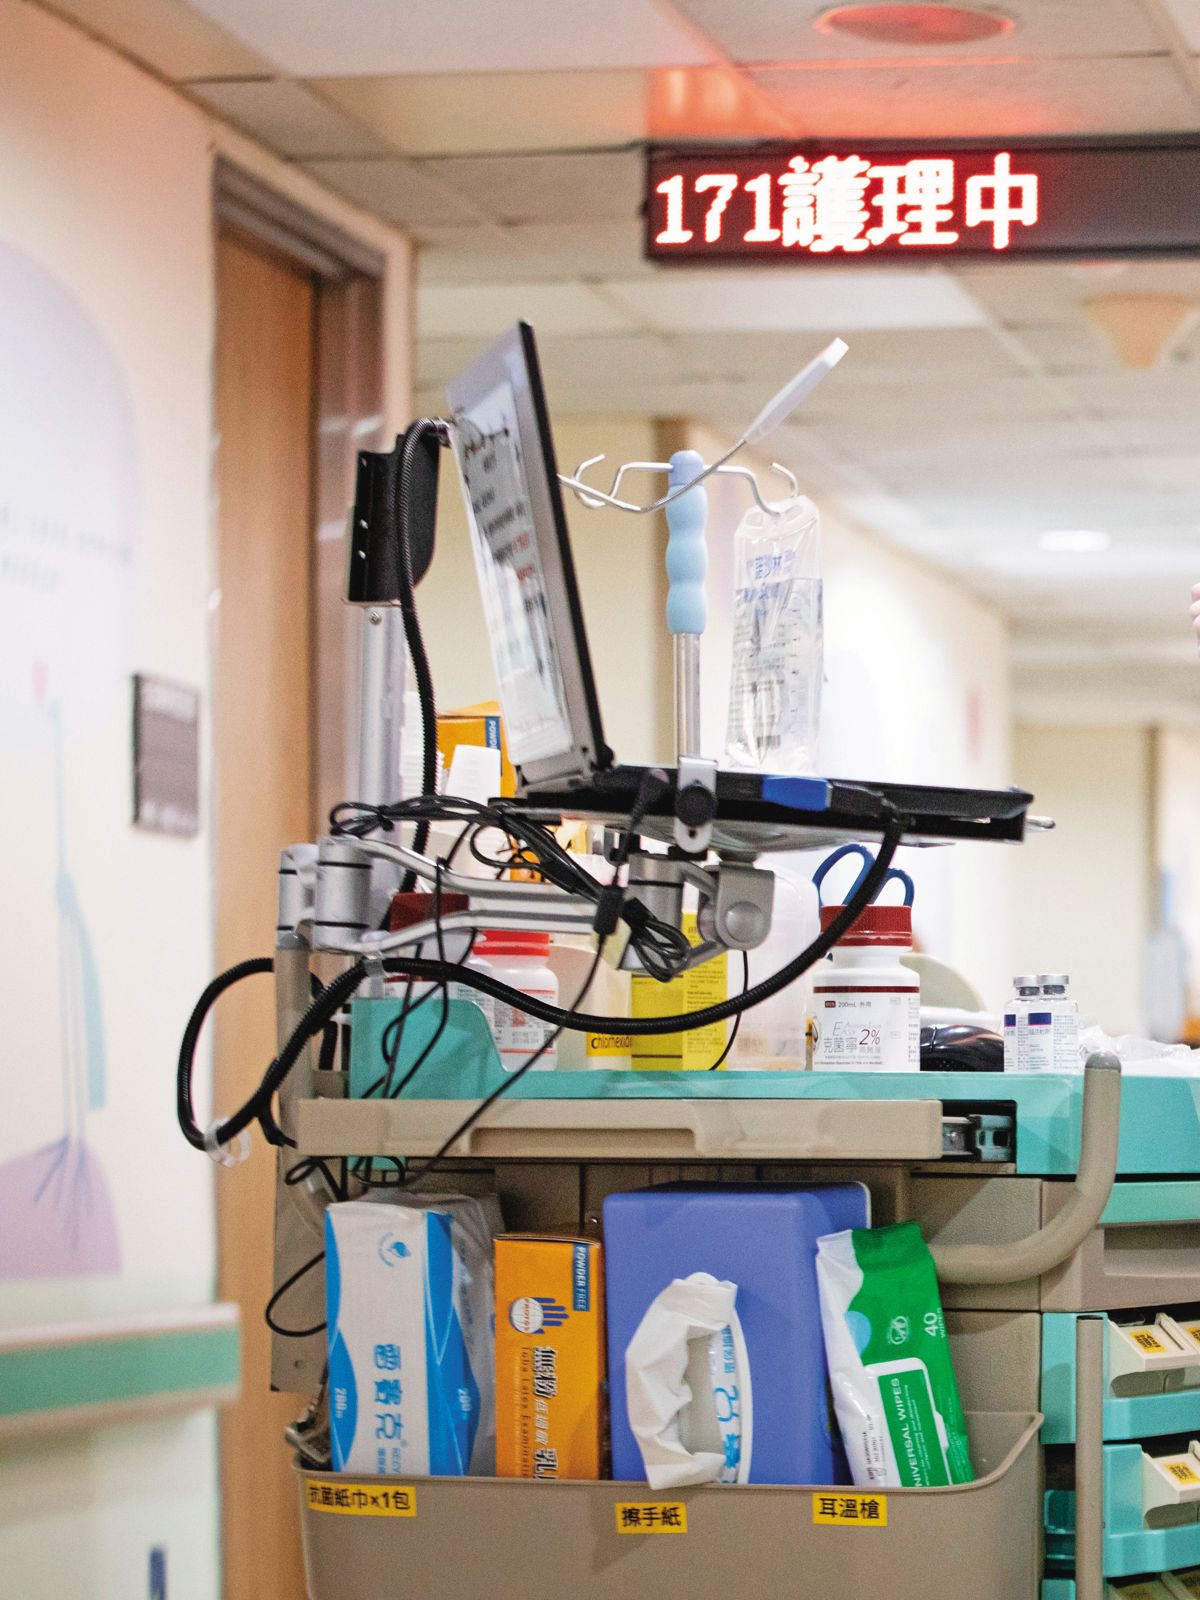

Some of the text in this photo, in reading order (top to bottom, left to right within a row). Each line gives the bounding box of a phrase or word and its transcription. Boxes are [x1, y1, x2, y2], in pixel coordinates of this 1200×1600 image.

[655, 152, 1039, 252] 171護理中
[859, 1028, 881, 1046] 2%
[575, 1246, 586, 1311] POWDER FREE
[923, 1312, 938, 1337] 40
[891, 1377, 907, 1421] WIPES
[621, 1506, 682, 1528] 擦手紙
[818, 1497, 880, 1519] 耳溫槍
